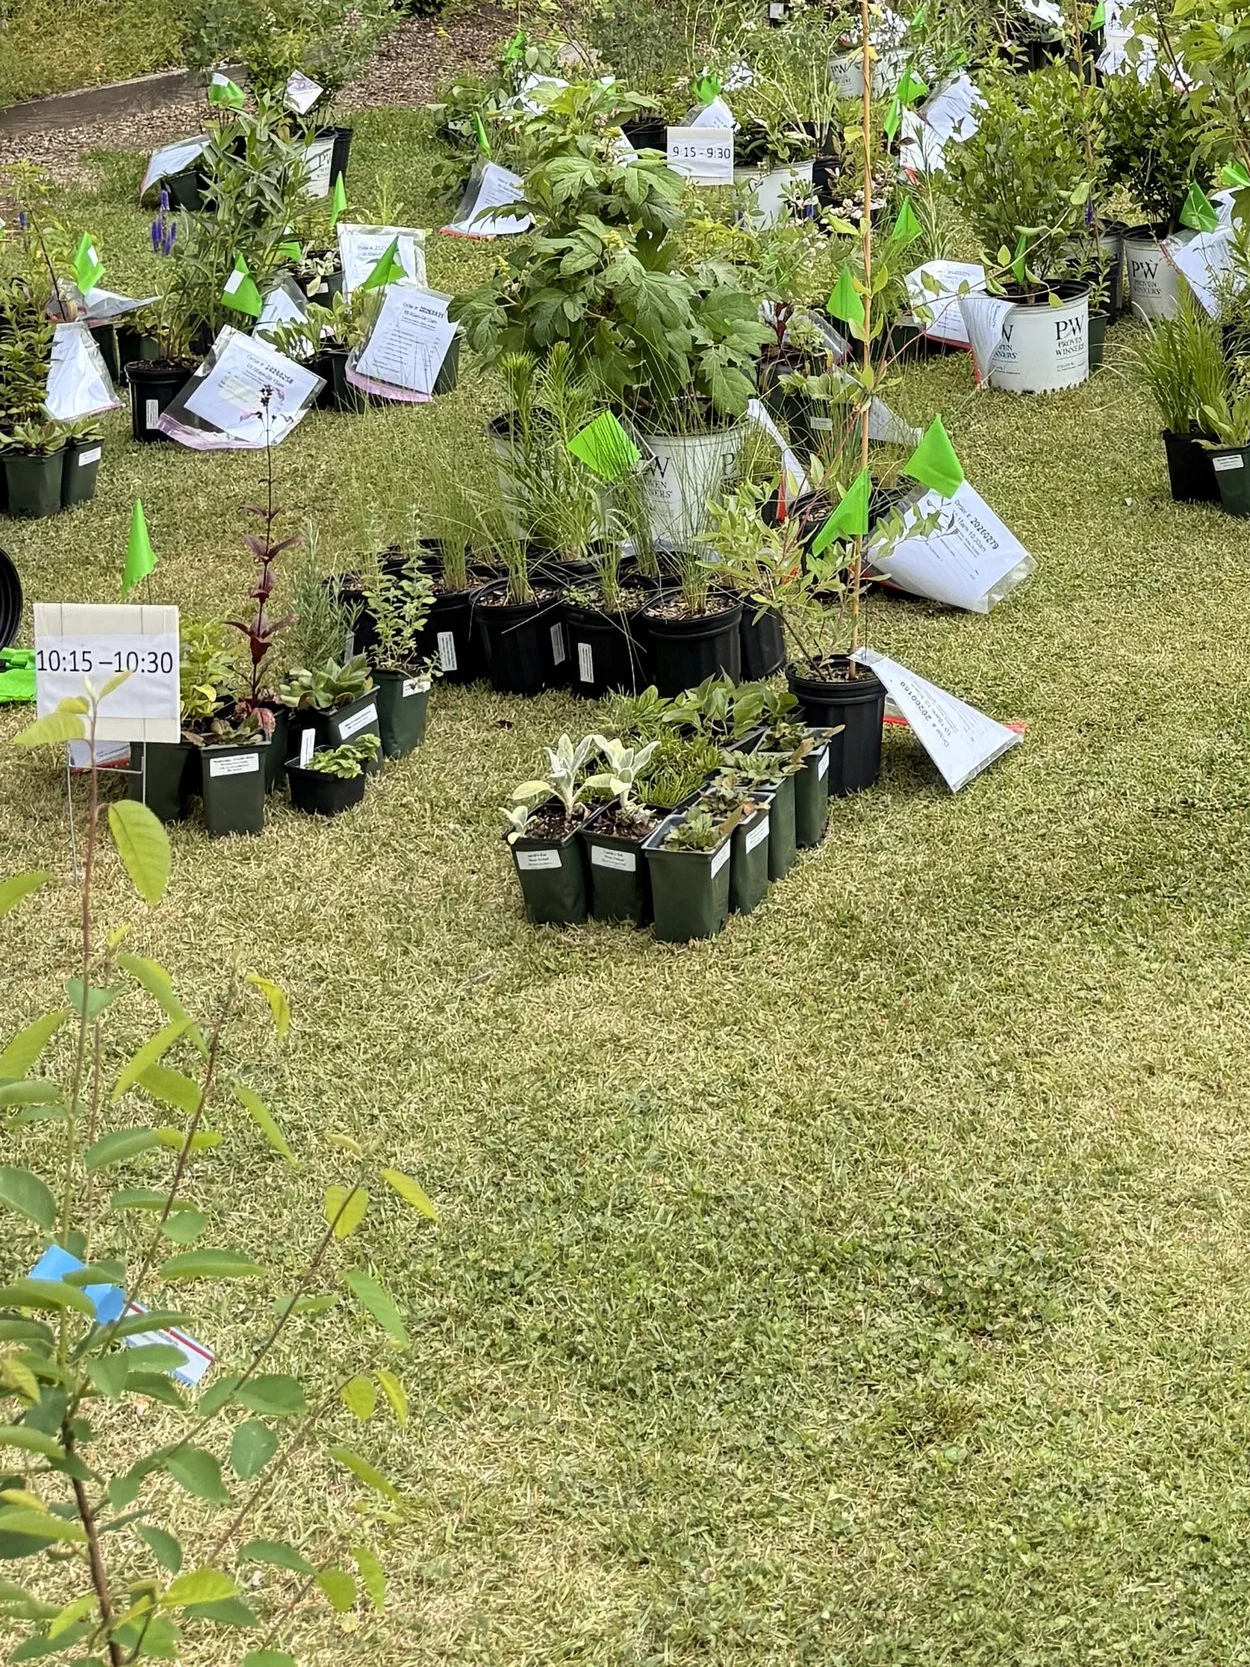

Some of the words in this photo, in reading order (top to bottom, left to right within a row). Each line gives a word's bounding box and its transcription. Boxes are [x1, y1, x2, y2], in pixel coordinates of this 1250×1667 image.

[706, 147, 731, 160] 9:30
[1131, 260, 1159, 280] PW
[1054, 315, 1085, 341] PW
[36, 649, 93, 673] 10:15
